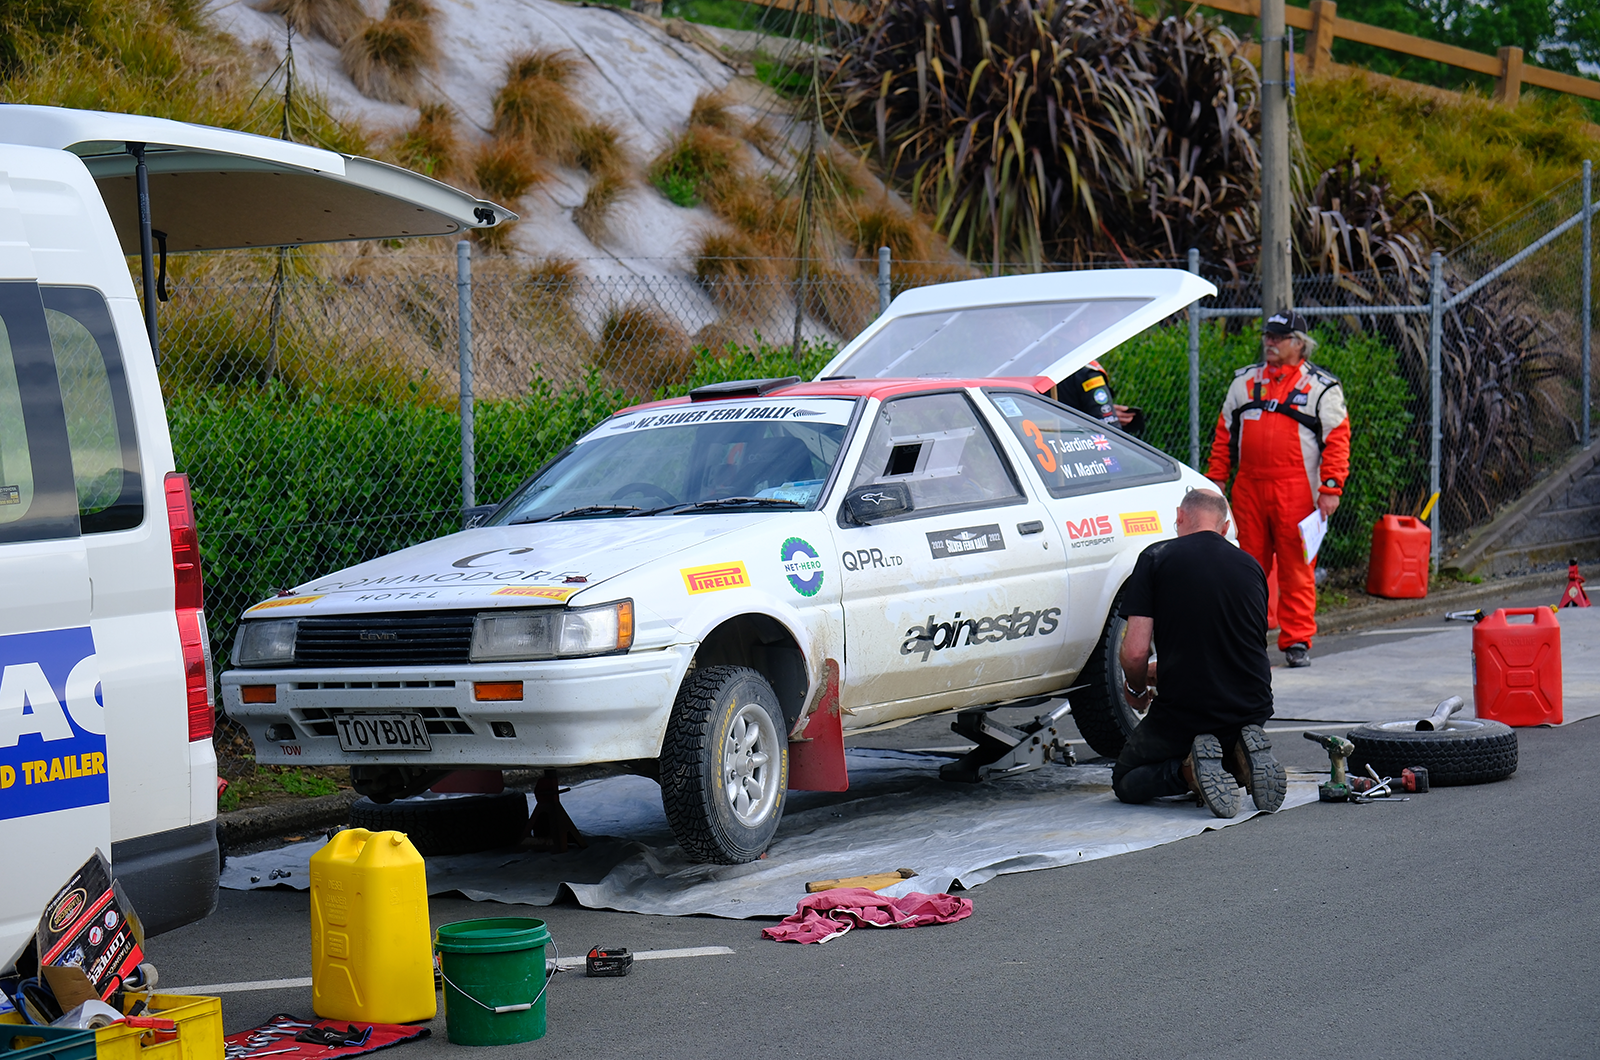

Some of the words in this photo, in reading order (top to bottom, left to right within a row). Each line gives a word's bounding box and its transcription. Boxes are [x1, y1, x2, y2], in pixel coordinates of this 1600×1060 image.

[634, 416, 659, 429] NZ
[654, 410, 707, 426] SILVER
[705, 407, 748, 421] FERN
[744, 406, 796, 420] RALLY
[1022, 419, 1057, 473] 3
[1048, 440, 1059, 454] T
[1059, 436, 1096, 454] Jardine
[1060, 463, 1077, 479] W.
[1074, 460, 1108, 477] Martin
[1066, 515, 1112, 539] MIS
[1123, 516, 1158, 533] PIRELLI
[931, 540, 944, 549] 2022
[988, 533, 1000, 541] 2022
[1071, 536, 1115, 548] MOTORSPORT
[784, 560, 821, 572] NET-HERO
[842, 547, 885, 571] QPR
[884, 556, 903, 567] LTD
[313, 570, 580, 592] COMMODORE
[687, 567, 744, 591] PIRELLI
[355, 591, 438, 602] HOTEL
[499, 588, 568, 597] PIRELLI
[900, 606, 1062, 662] alpinestars
[1502, 636, 1536, 646] GASOLINE
[338, 717, 427, 745] TOYBDA
[280, 745, 301, 755] TOW
[22, 751, 106, 785] TRAILER
